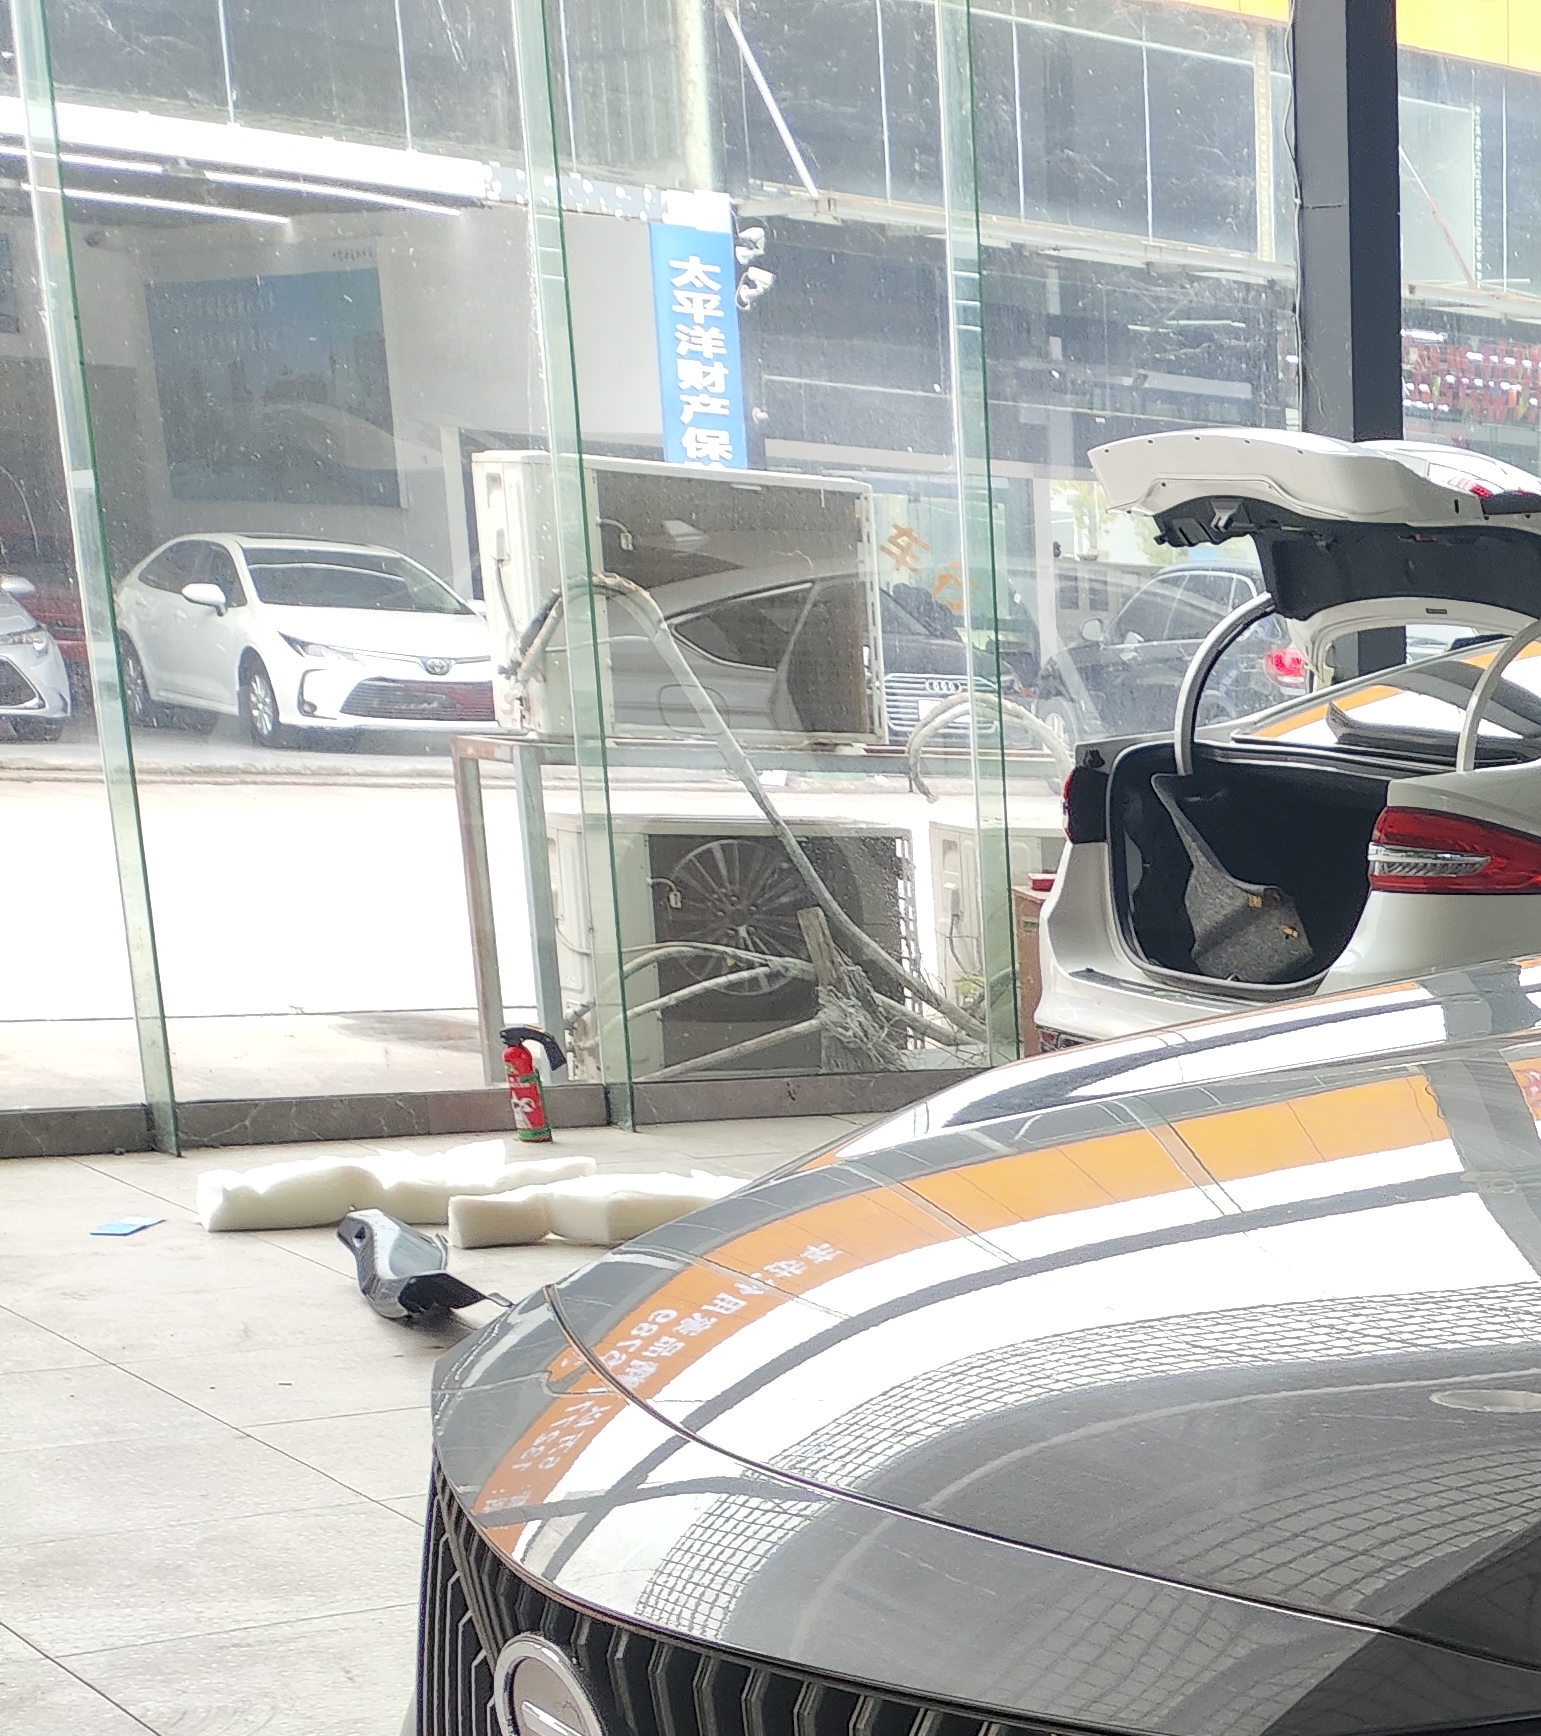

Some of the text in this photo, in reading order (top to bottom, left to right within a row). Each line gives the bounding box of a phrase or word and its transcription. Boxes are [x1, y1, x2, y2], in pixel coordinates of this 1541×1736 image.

[669, 255, 735, 468] 太平洋财产保
